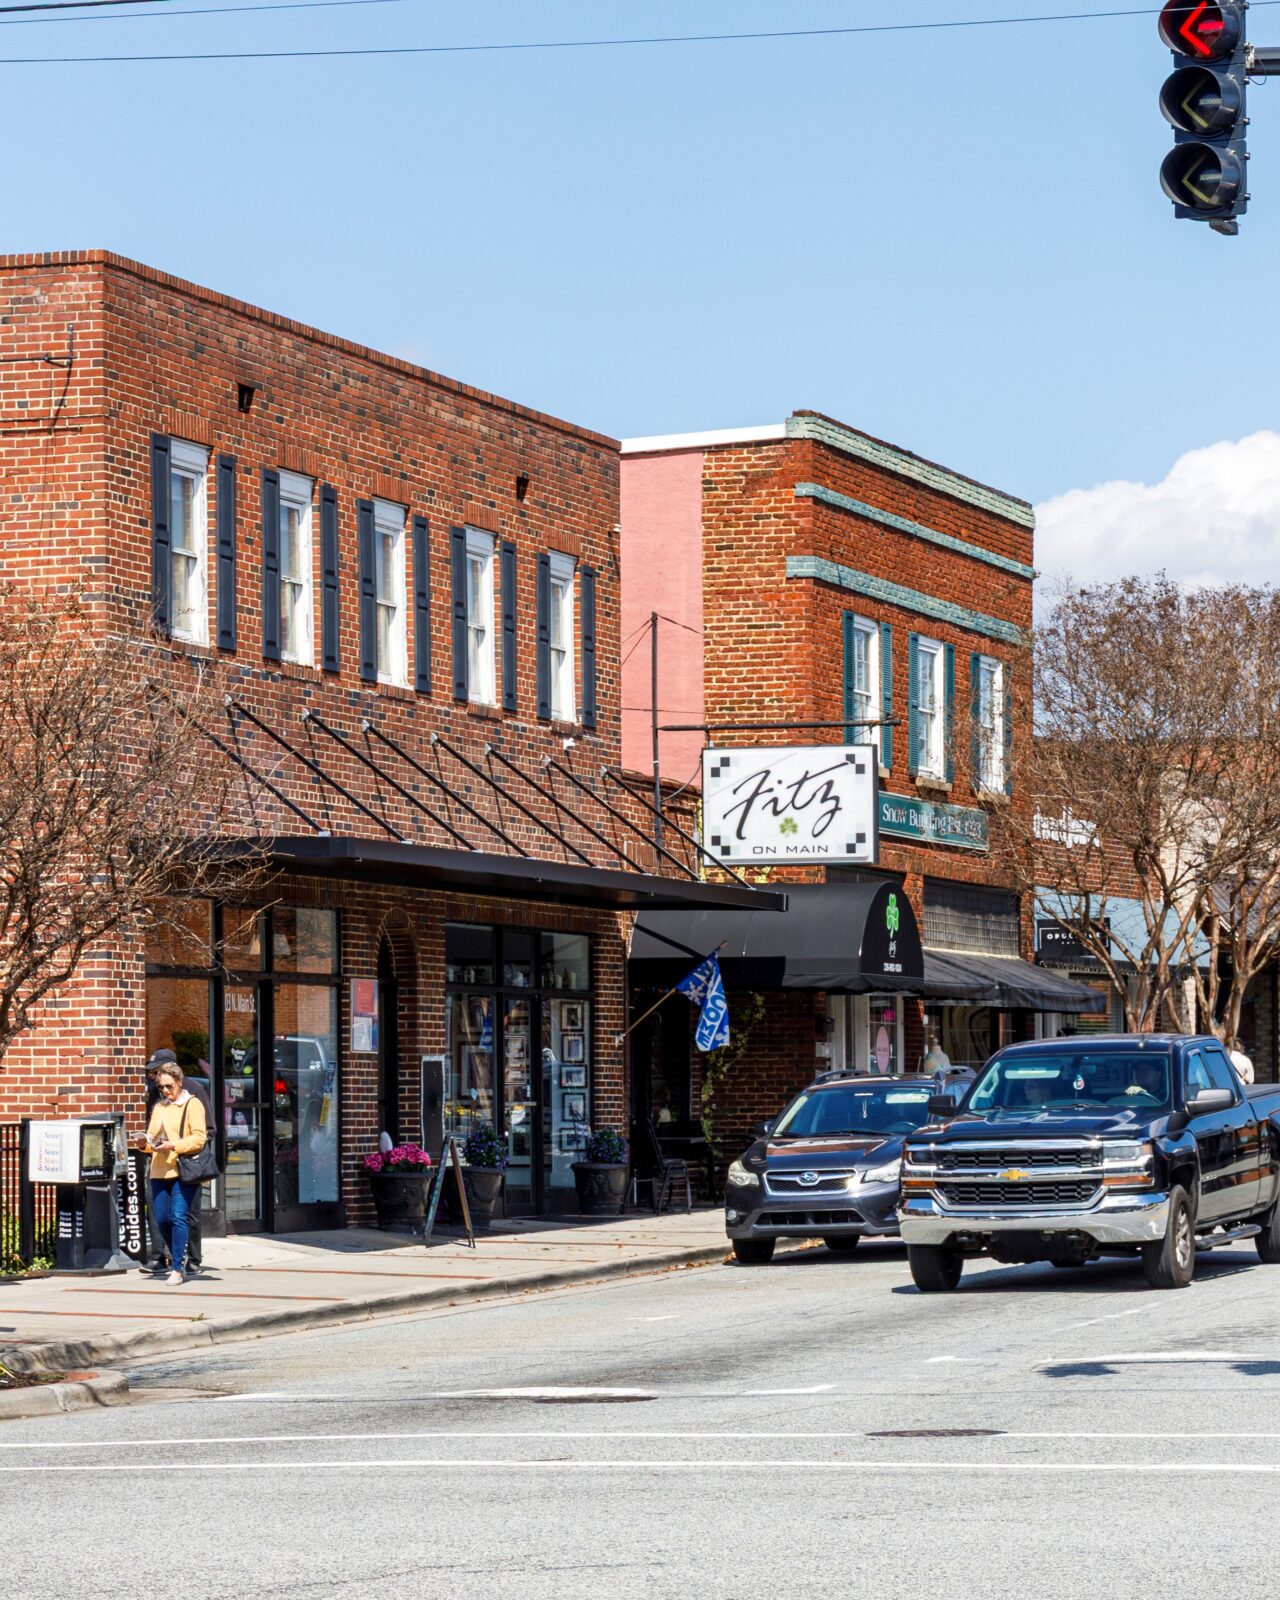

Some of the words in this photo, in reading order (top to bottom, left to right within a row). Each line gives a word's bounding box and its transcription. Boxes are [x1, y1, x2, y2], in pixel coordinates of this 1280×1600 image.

[722, 761, 851, 840] Fitz
[882, 803, 907, 825] Snow
[909, 808, 946, 835] Building
[752, 845, 777, 855] ON
[785, 844, 829, 854] MAIN
[126, 1156, 141, 1253] Guides.com
